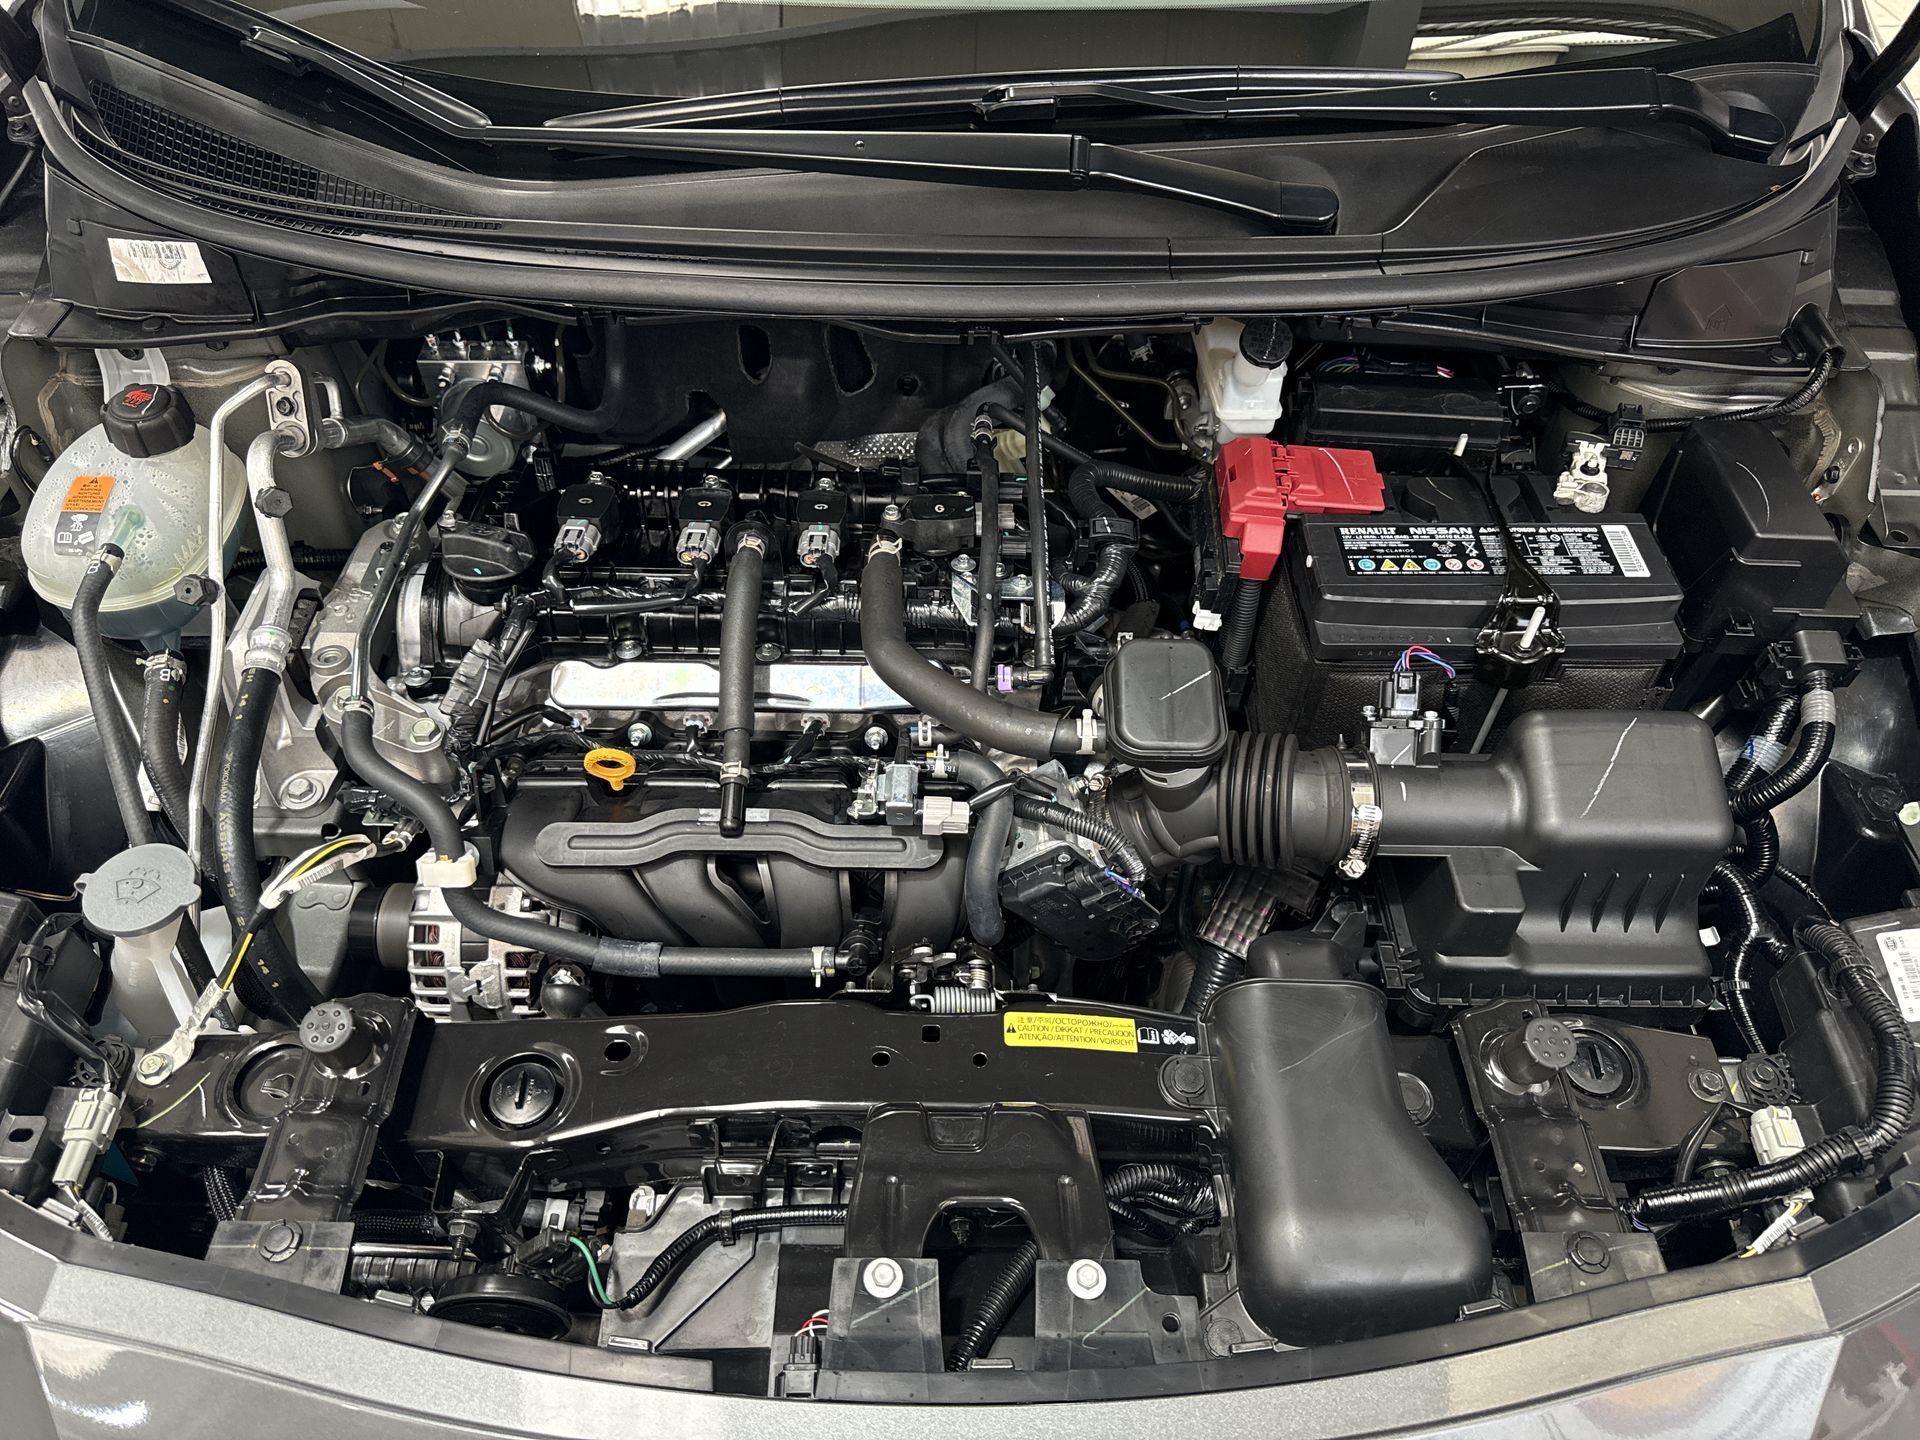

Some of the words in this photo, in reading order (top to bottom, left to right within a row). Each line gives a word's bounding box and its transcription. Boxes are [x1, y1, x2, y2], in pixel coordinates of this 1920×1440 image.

[934, 504, 945, 513] G
[1339, 527, 1396, 535] RENAULT
[1408, 527, 1473, 535] NISSAN
[160, 668, 171, 682] B
[219, 762, 232, 804] YOKOHAMA
[1017, 1023, 1049, 1032] CAUTION
